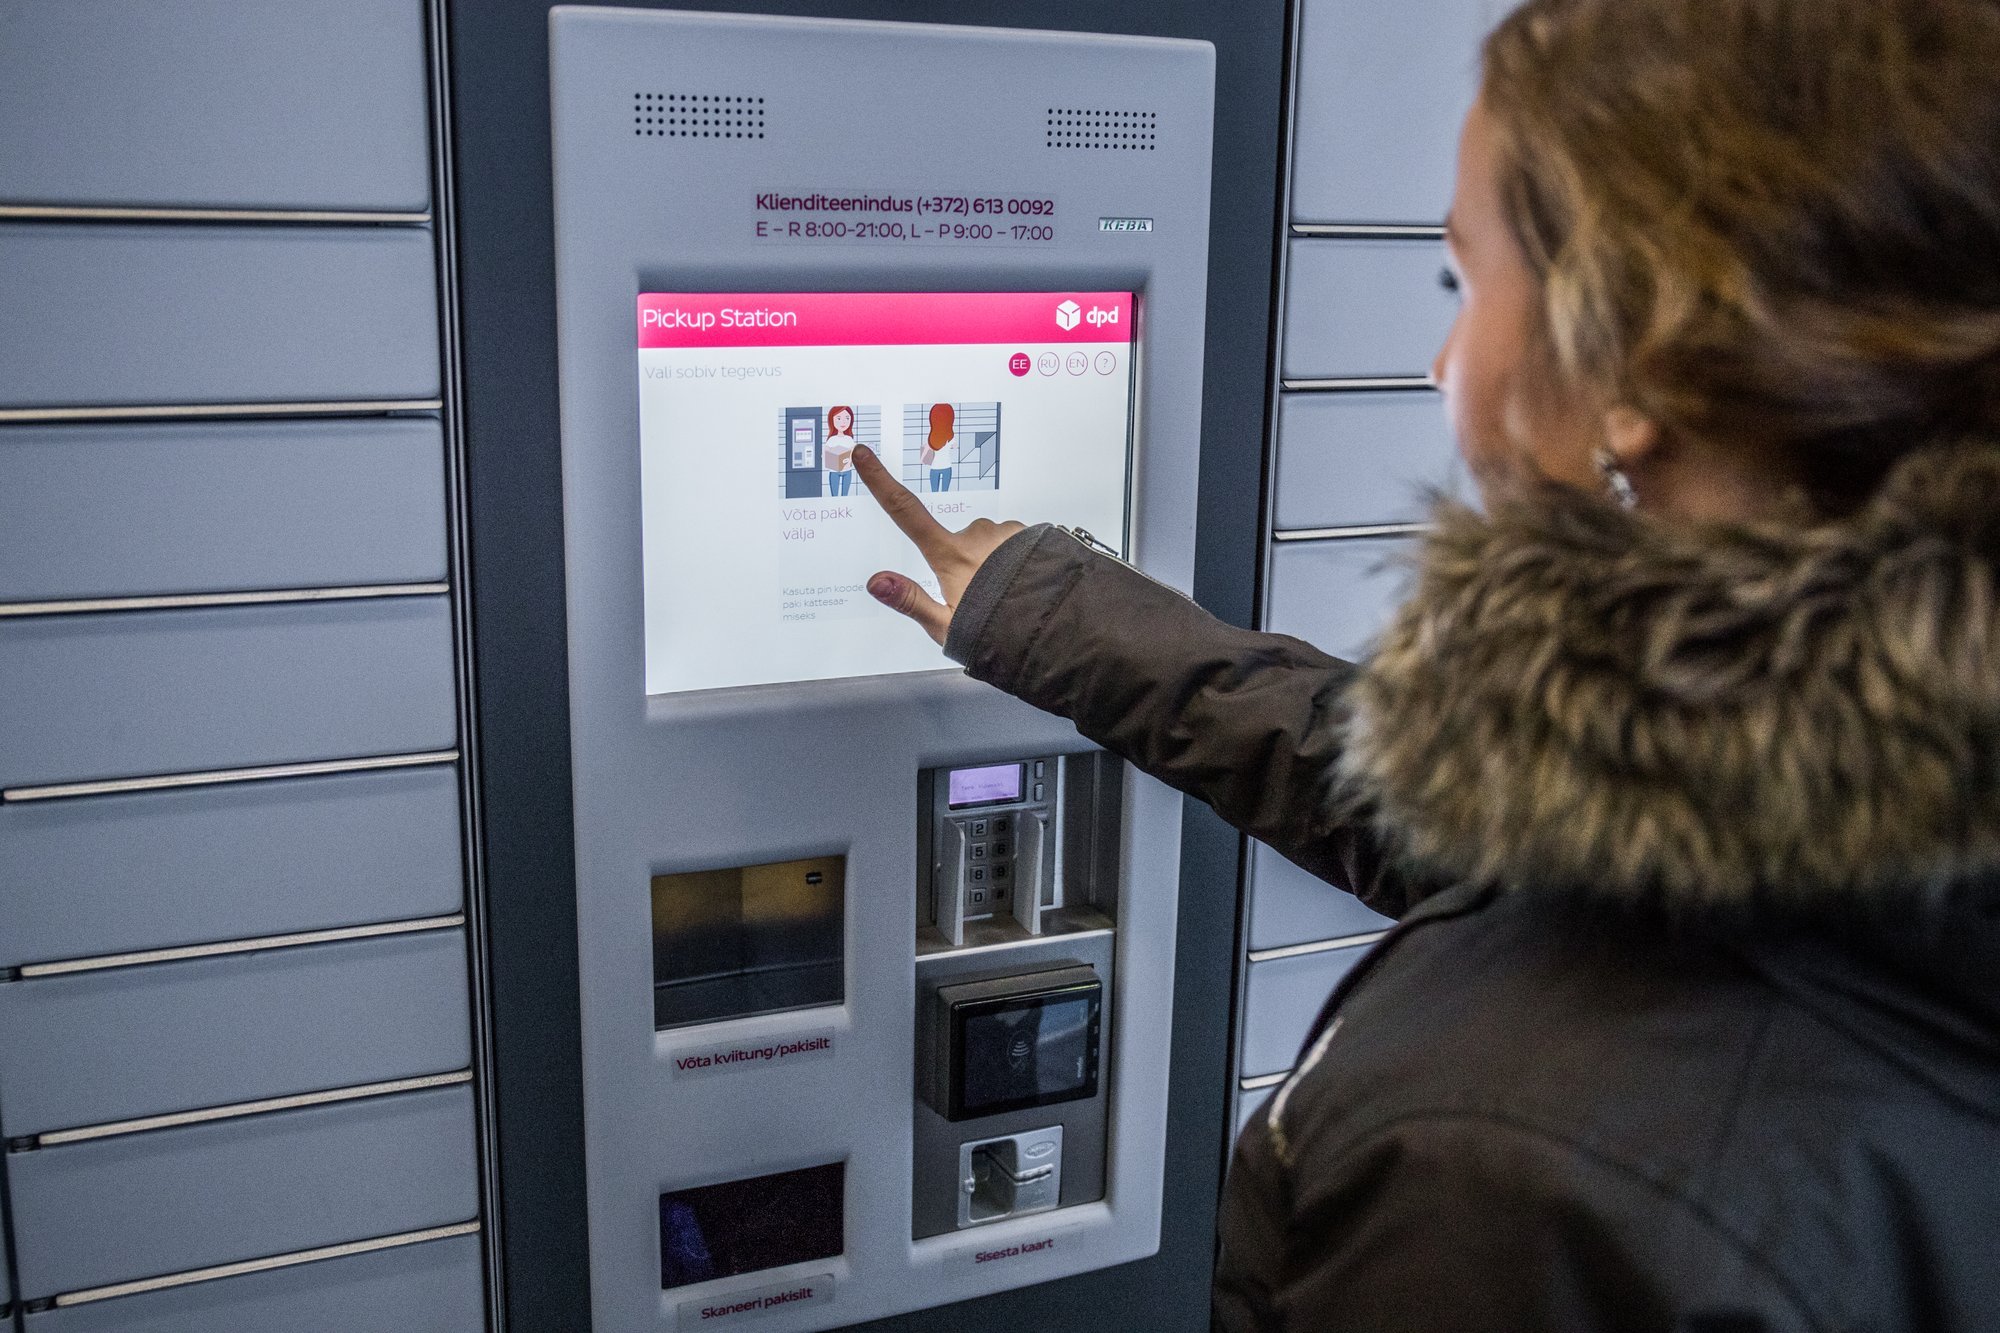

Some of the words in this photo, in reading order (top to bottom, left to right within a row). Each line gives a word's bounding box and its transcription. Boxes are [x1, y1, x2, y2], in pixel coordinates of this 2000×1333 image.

[756, 193, 914, 212] Klienditeenindus
[917, 196, 969, 216] (+372)
[973, 198, 1004, 214] 613
[1007, 199, 1054, 215] 0092
[756, 221, 768, 237] E
[788, 222, 801, 237] R
[911, 223, 921, 238] L
[939, 224, 951, 238] P
[953, 223, 993, 239] 9:00
[1010, 225, 1054, 240] 17:00
[1103, 219, 1148, 231] KEBA
[643, 309, 715, 331] Pickup
[720, 308, 797, 328] Station
[1086, 306, 1119, 328] dpd
[1012, 359, 1028, 370] EE
[1040, 359, 1056, 369] RU
[1069, 358, 1085, 369] EN
[644, 366, 672, 379] Vali
[676, 365, 717, 379] sobiv
[721, 365, 782, 381] tegevus
[782, 508, 817, 521] Võta
[820, 506, 853, 523] pakk
[782, 527, 815, 542] välja
[783, 586, 815, 596] Kasuta
[817, 586, 832, 596] pin
[783, 612, 816, 621] miseks
[976, 823, 984, 834] 2
[975, 846, 983, 857] 5
[975, 869, 983, 880] 8
[676, 1053, 711, 1071] Võta
[714, 1037, 831, 1065] kviitung/pakisilt
[975, 1247, 1019, 1264] Sisesta
[1022, 1238, 1054, 1254] kaart
[701, 1297, 762, 1320] Skaneeri
[764, 1287, 814, 1310] pakisilt
